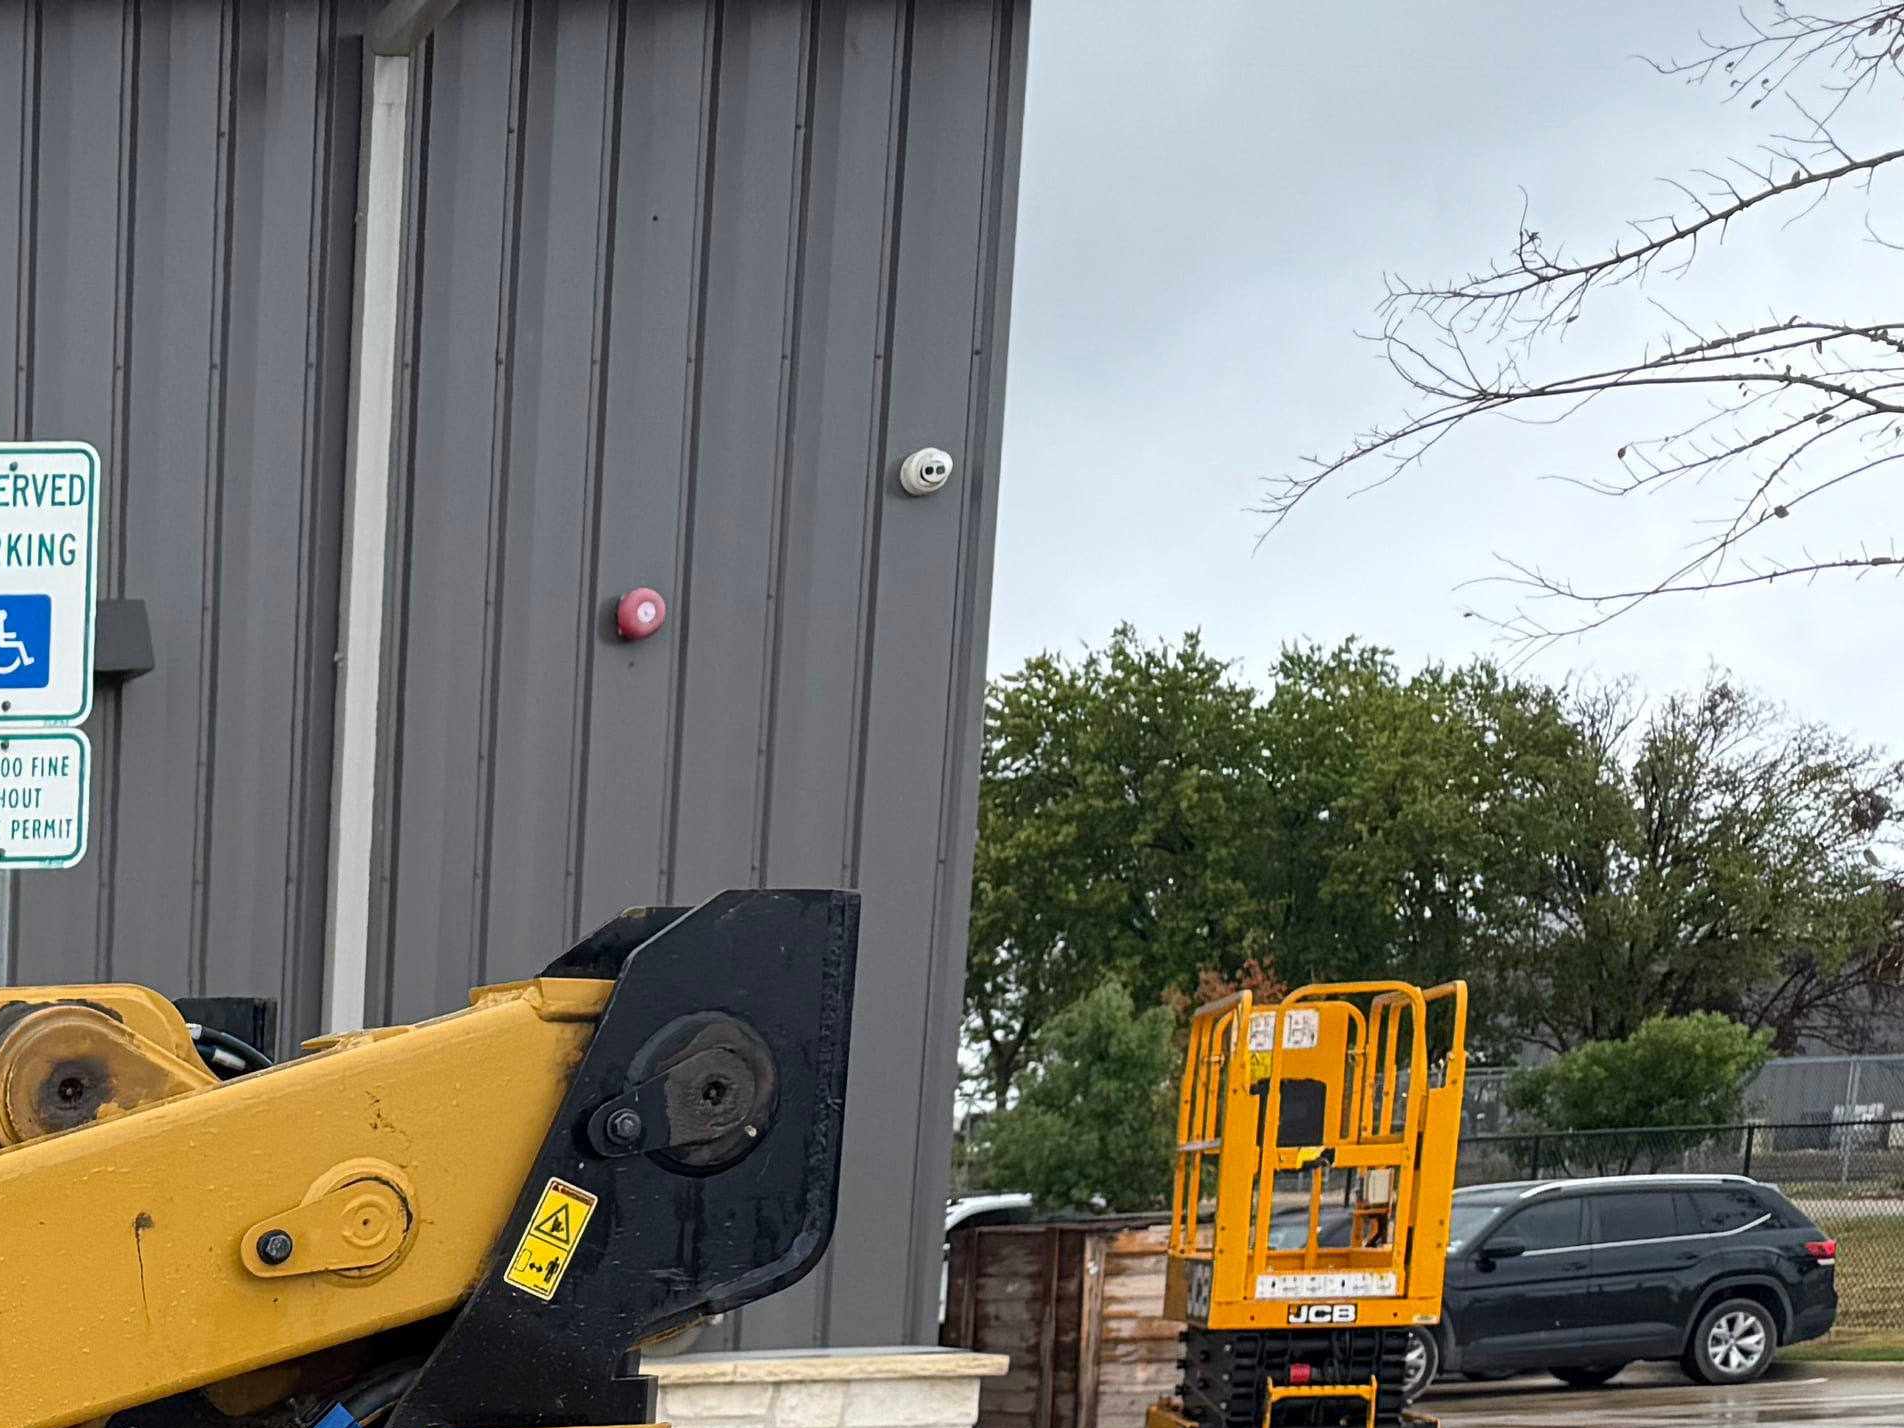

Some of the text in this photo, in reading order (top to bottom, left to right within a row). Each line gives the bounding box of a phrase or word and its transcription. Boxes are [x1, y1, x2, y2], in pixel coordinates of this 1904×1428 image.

[31, 755, 70, 777] FINE
[11, 818, 73, 841] PERMIT
[1288, 1304, 1356, 1323] JCB
